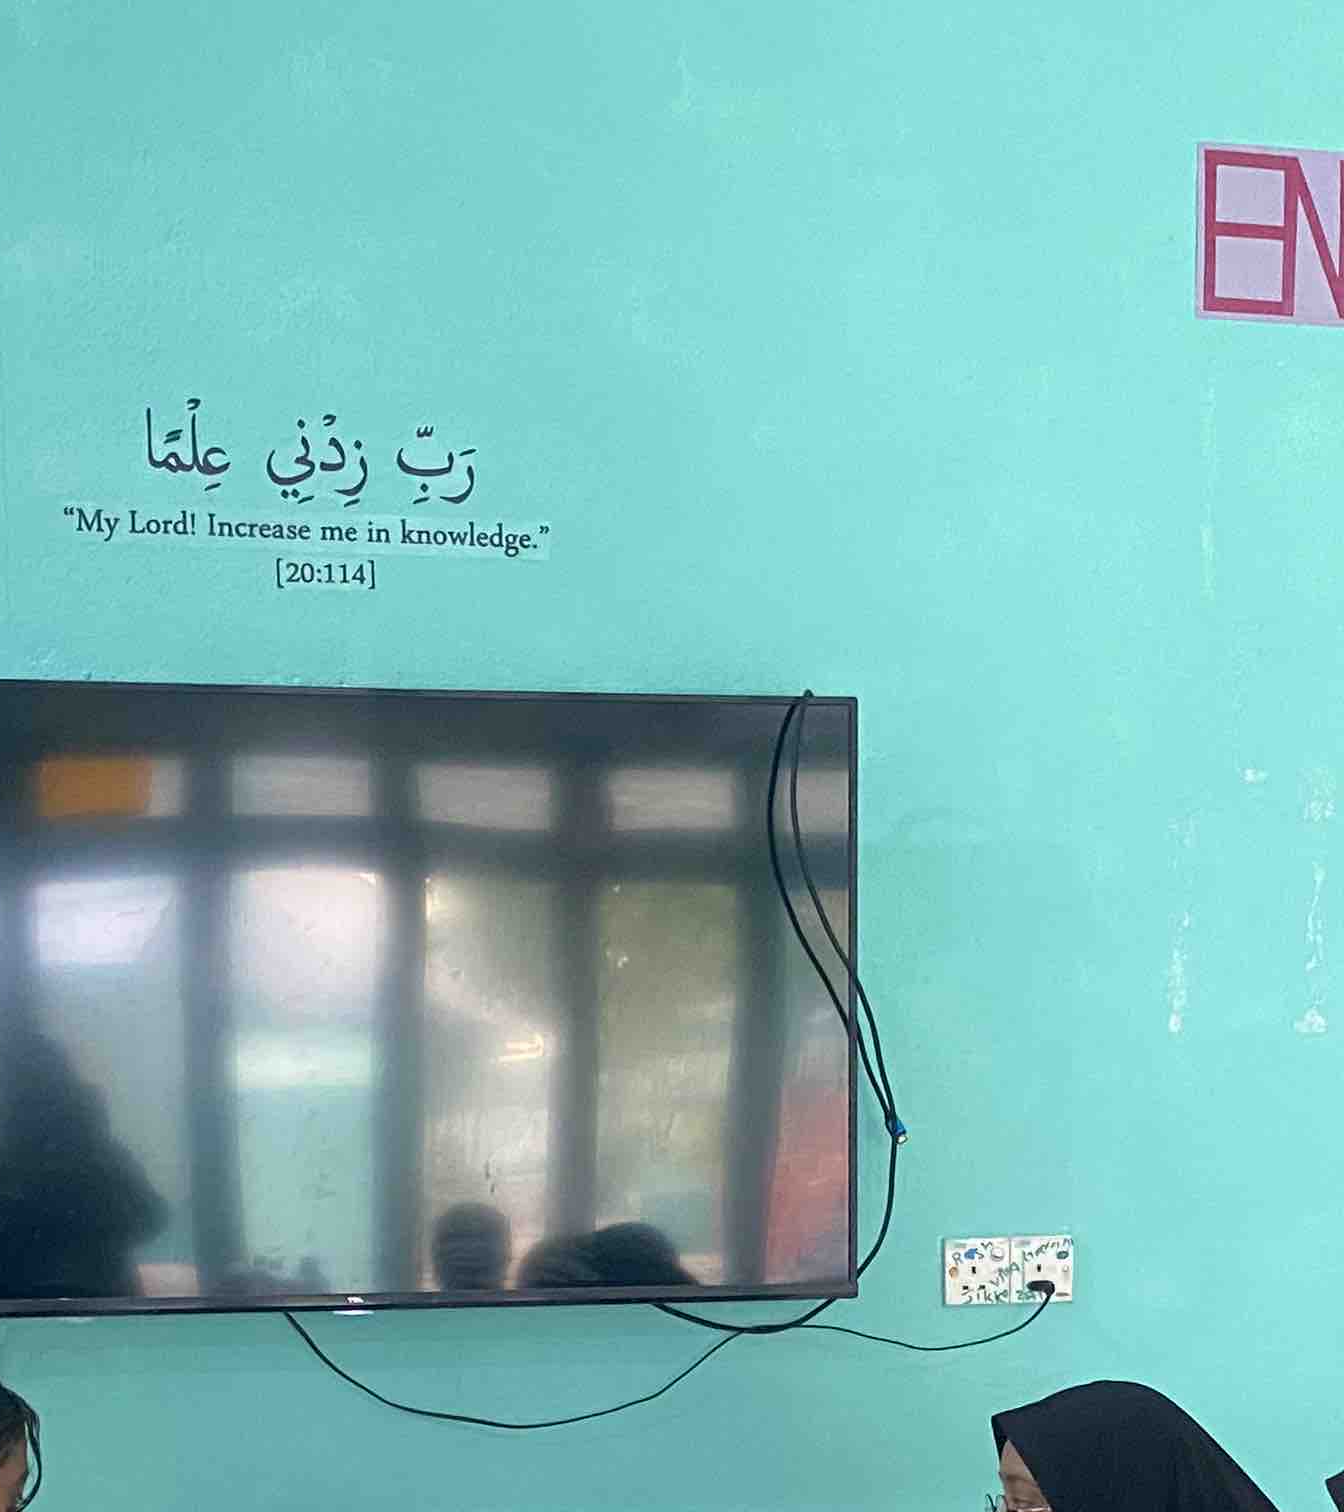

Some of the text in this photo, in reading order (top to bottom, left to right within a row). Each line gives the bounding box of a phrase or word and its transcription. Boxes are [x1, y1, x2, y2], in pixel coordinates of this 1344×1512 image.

[128, 510, 197, 537] Lord!
[208, 514, 311, 541] Increase
[320, 524, 358, 543] me
[367, 521, 391, 545] in
[275, 558, 377, 589] [20:114]
